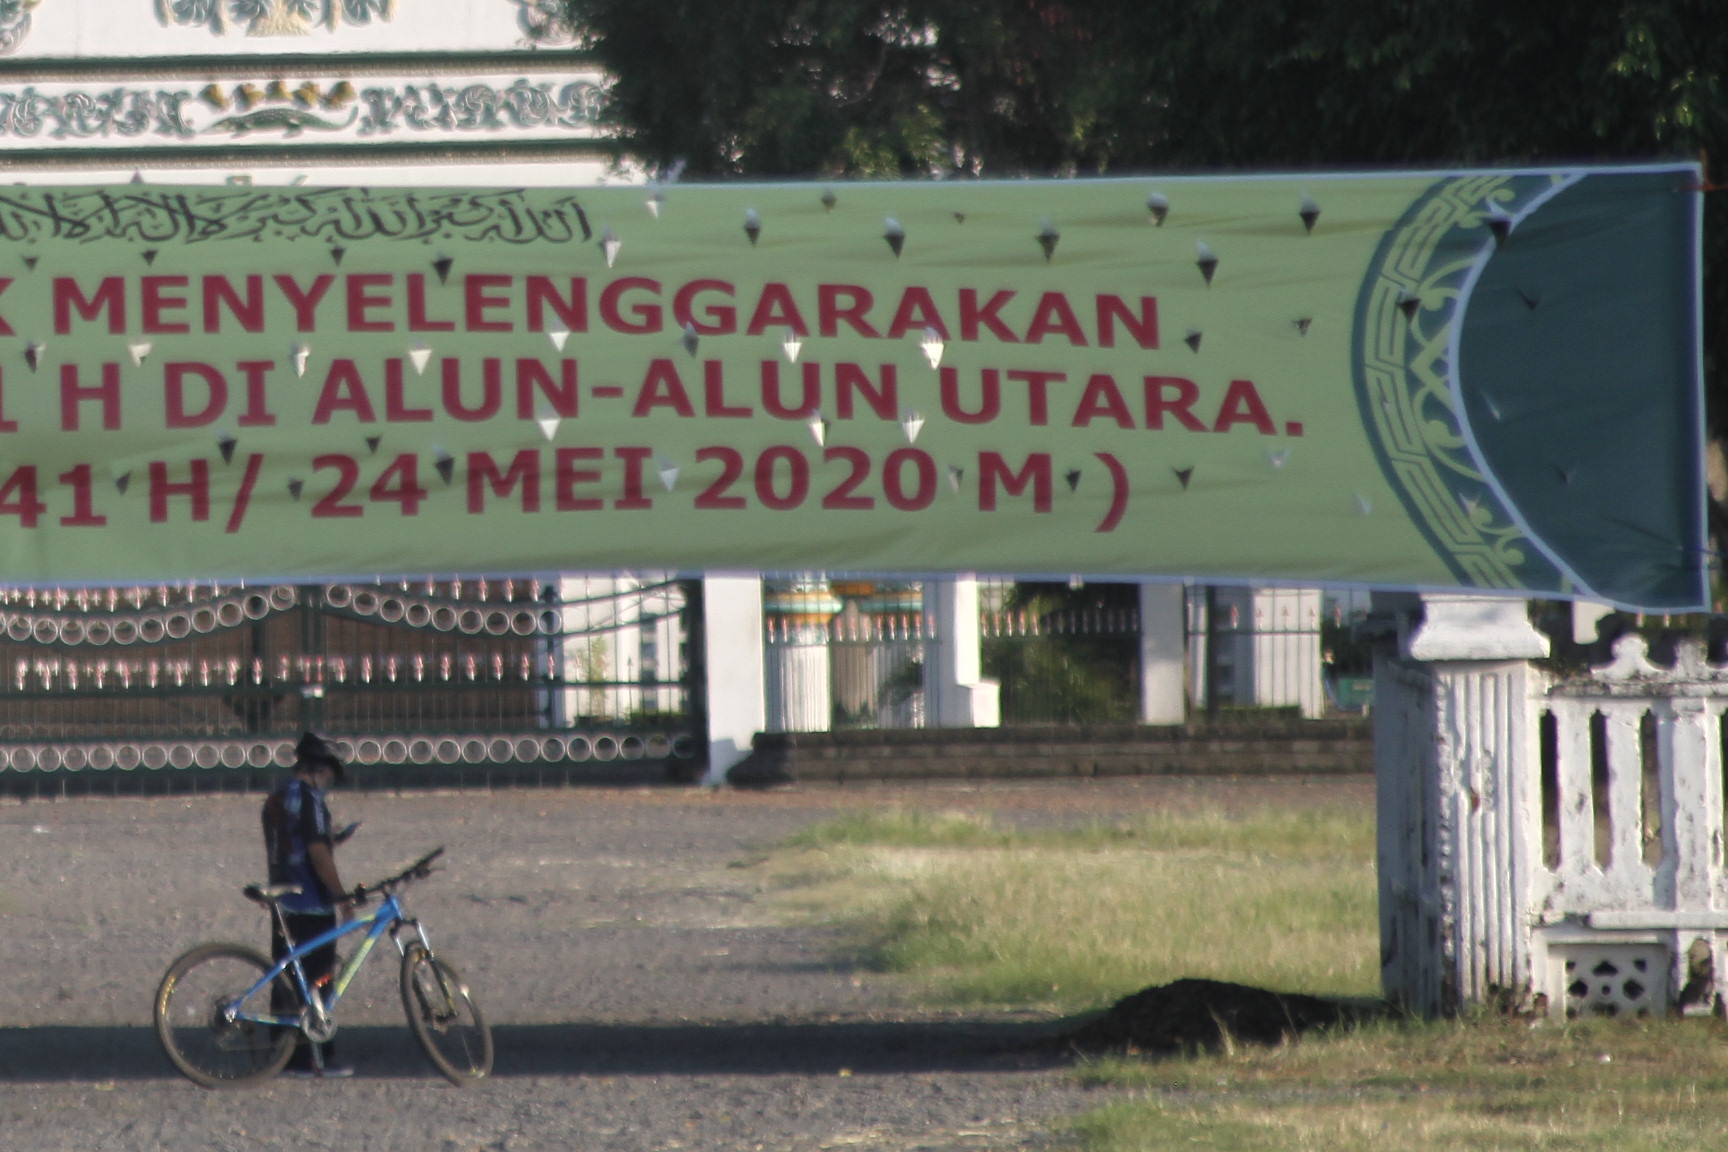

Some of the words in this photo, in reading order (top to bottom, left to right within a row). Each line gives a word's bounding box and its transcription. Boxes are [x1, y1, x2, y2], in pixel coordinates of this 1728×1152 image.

[53, 272, 1160, 349] MENYELENGGARAKAN
[59, 361, 122, 431] H
[164, 359, 276, 428] DI
[313, 356, 899, 424] ALUN-ALUN
[939, 366, 1303, 436] UTARA.
[311, 452, 427, 517] 24
[467, 446, 653, 514] MEI
[695, 444, 938, 512] 2020
[978, 450, 1053, 513] M
